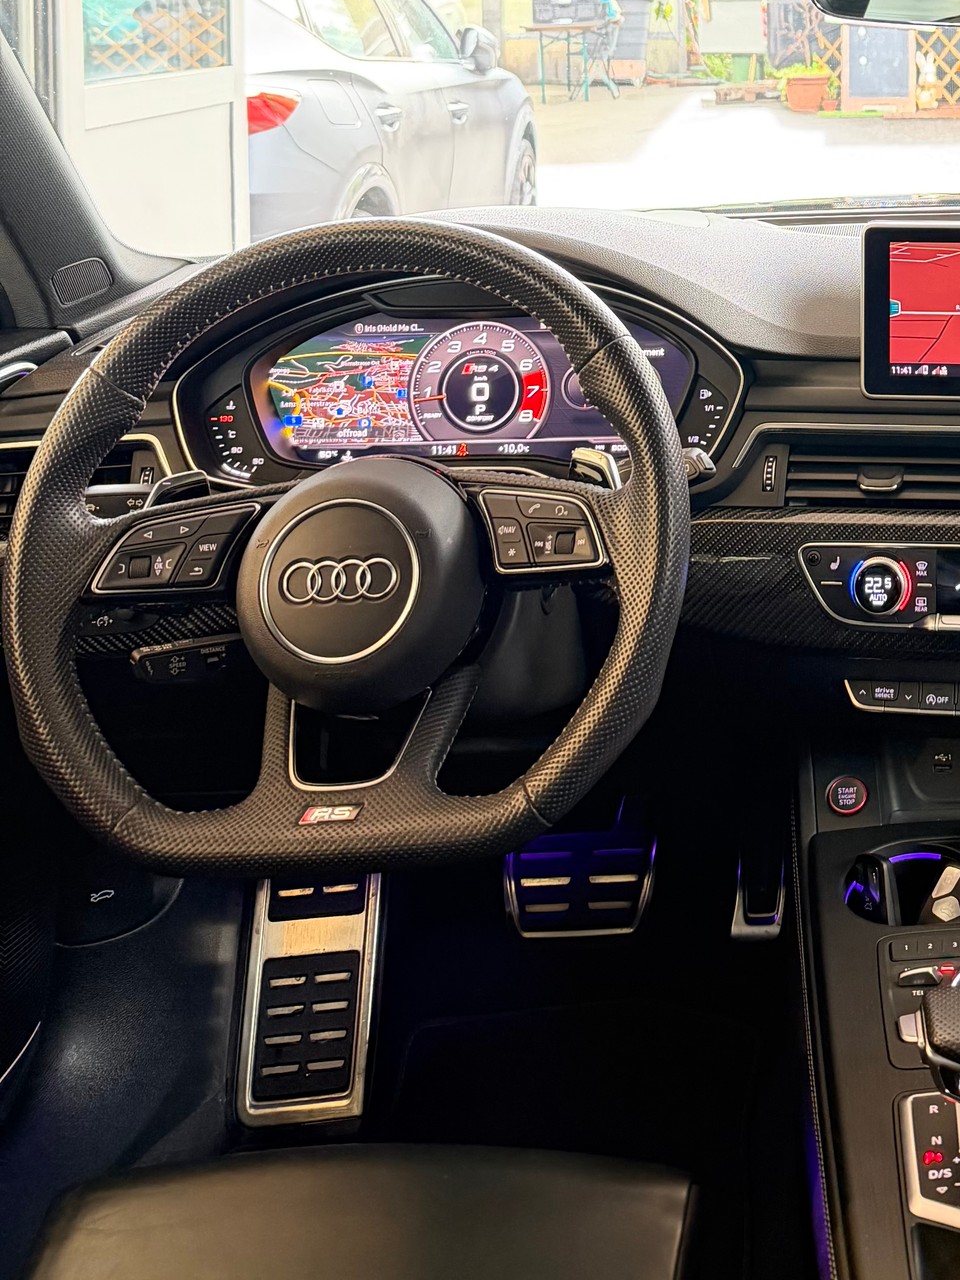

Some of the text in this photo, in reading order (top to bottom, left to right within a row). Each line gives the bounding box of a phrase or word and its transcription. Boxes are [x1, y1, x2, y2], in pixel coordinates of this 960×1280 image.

[473, 332, 488, 345] 4
[447, 341, 462, 353] 3
[501, 339, 515, 352] 5
[427, 361, 442, 373] 2
[519, 359, 533, 371] 6
[891, 365, 912, 375] 11:41
[472, 382, 490, 402] 0
[526, 385, 540, 398] 7
[474, 405, 486, 415] P
[219, 415, 234, 423] 130
[518, 409, 533, 423] 8
[337, 429, 368, 437] offroad
[431, 445, 457, 455] 11:41
[199, 542, 218, 553] VIEW
[155, 560, 164, 570] OK
[915, 569, 928, 577] MAX
[864, 576, 892, 595] 22.5
[869, 592, 888, 602] AUTO
[914, 605, 928, 613] REAR
[200, 645, 226, 655] DISTANCE
[169, 661, 187, 669] SPEED
[874, 691, 895, 699] select
[875, 686, 895, 694] drive
[936, 695, 949, 704] OFF
[838, 798, 855, 806] STOP
[929, 1104, 939, 1114] R
[931, 1135, 942, 1146] N
[928, 1168, 953, 1181] D/S
